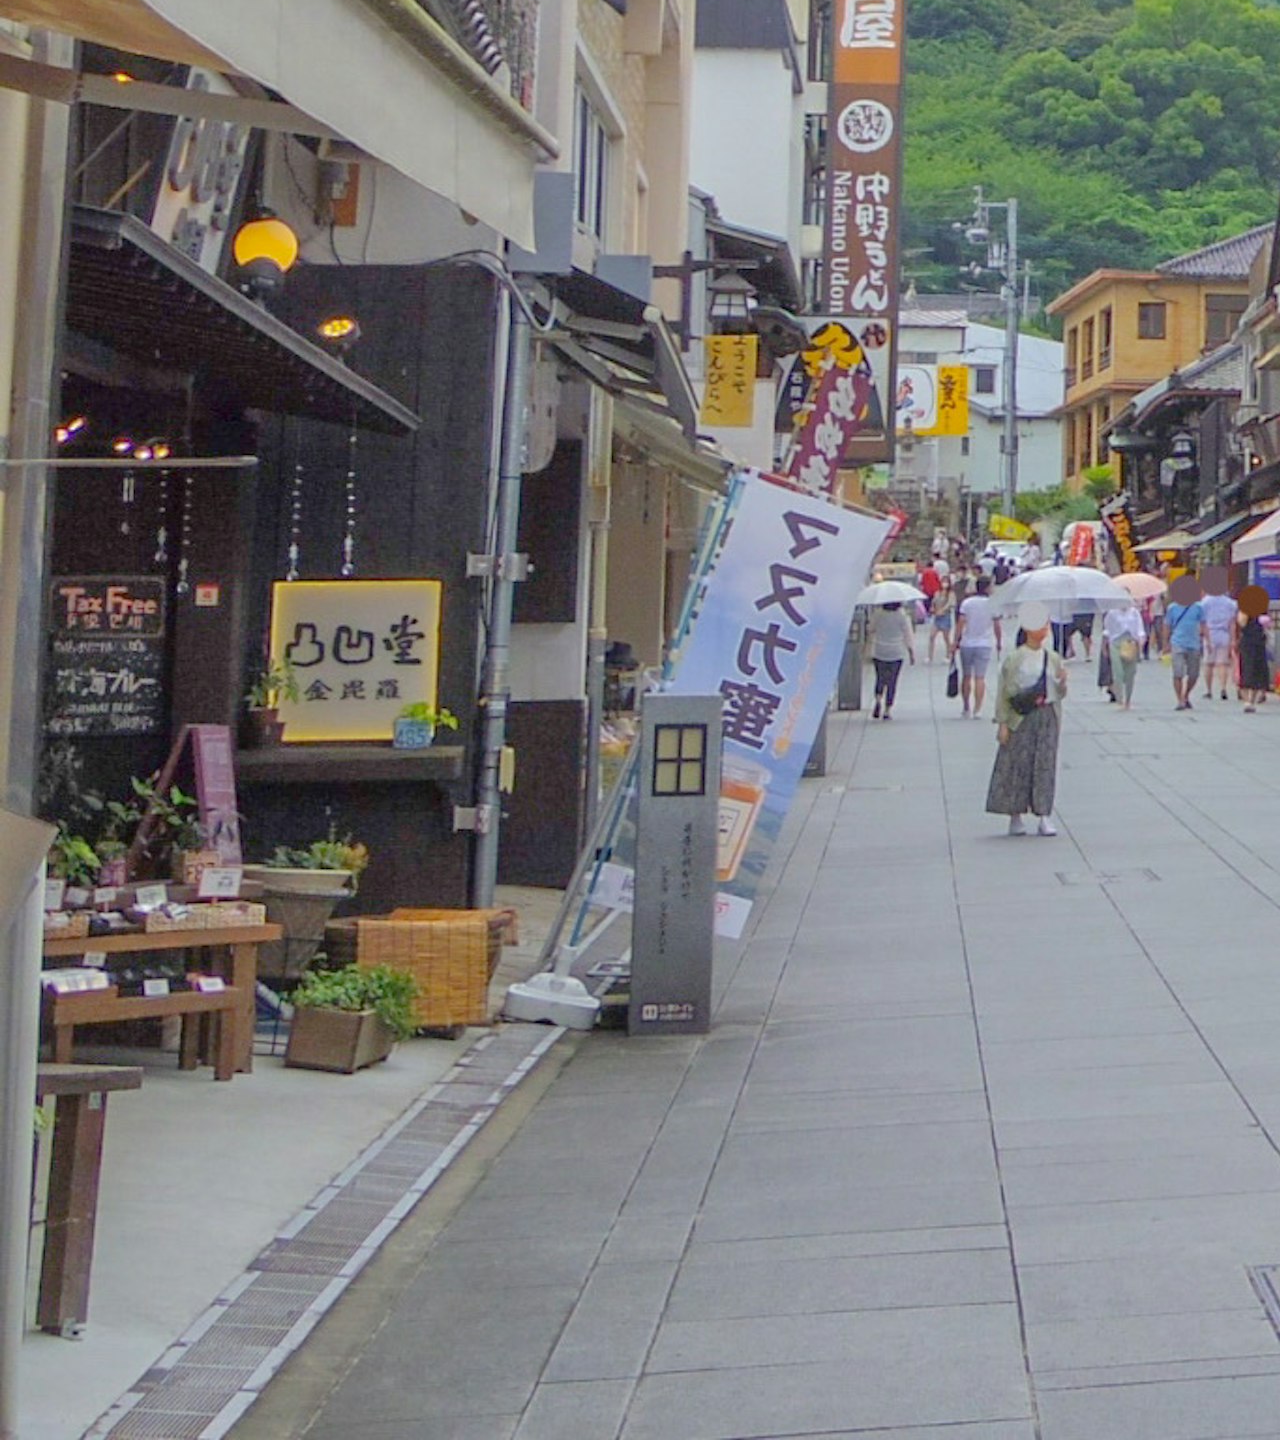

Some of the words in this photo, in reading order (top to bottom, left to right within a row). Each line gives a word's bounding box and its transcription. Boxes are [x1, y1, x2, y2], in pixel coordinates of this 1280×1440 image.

[832, 170, 852, 252] Nakano
[851, 171, 890, 311] 中野うどん
[830, 257, 850, 313] Udon
[59, 586, 103, 613] Tax
[106, 585, 158, 615] Free
[285, 614, 426, 667] 凸凹堂
